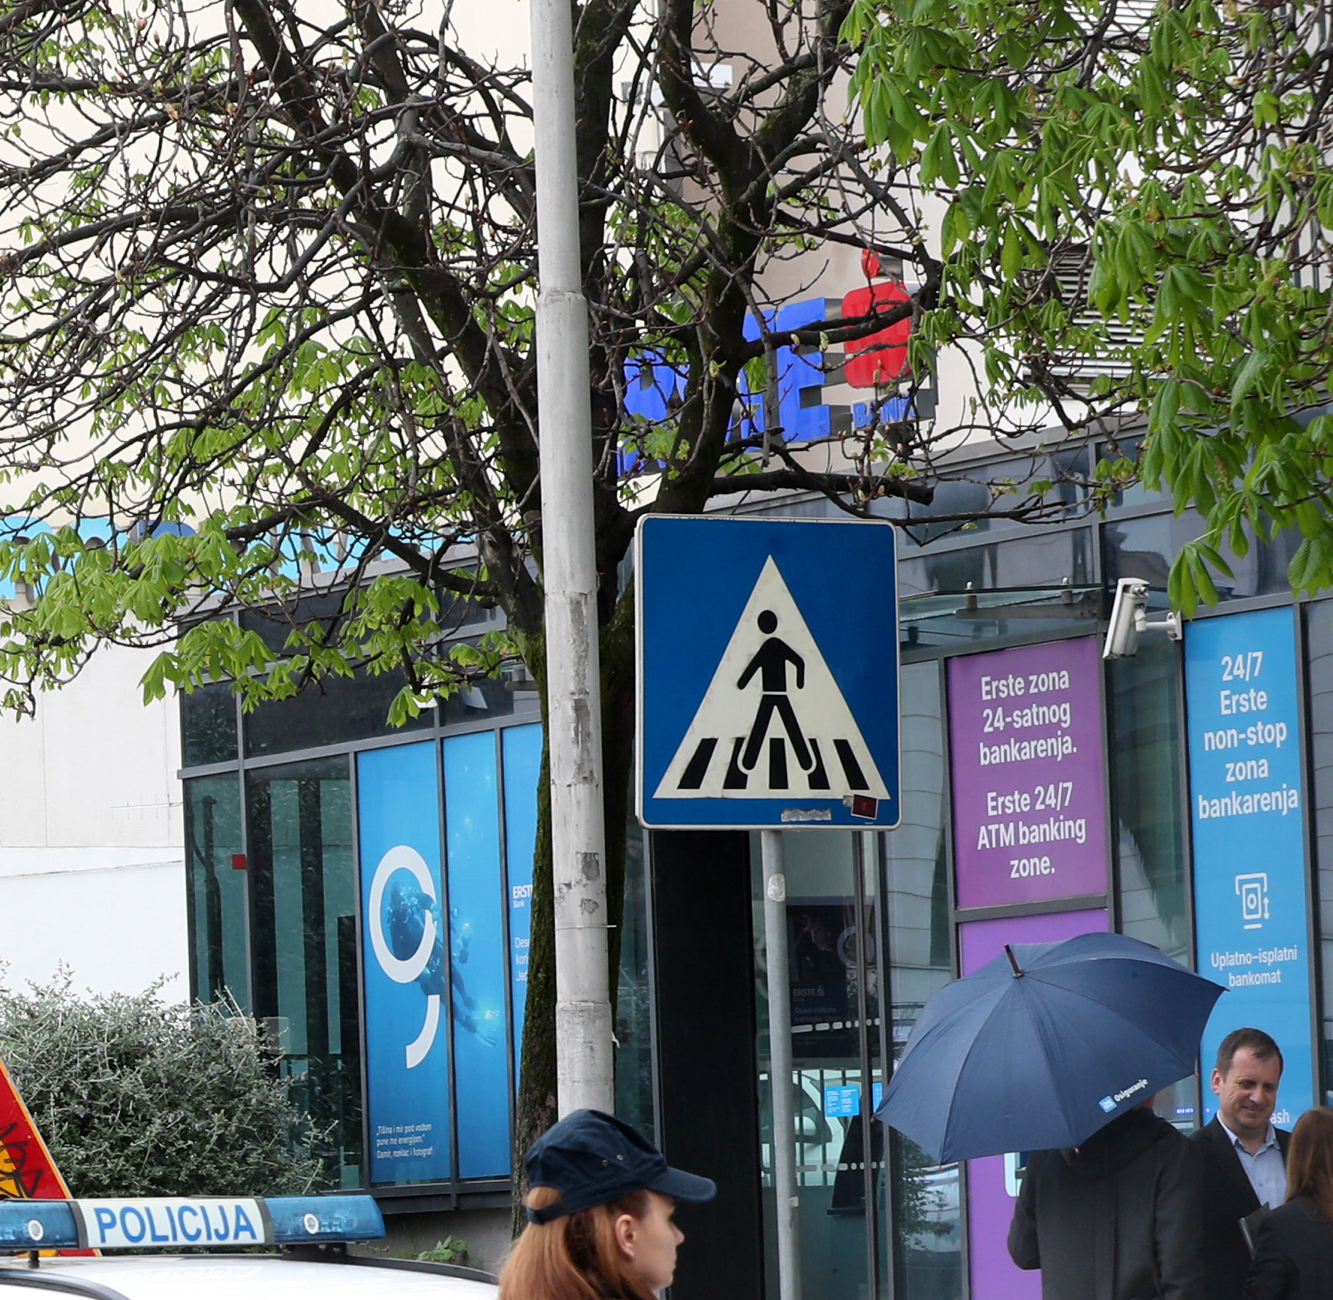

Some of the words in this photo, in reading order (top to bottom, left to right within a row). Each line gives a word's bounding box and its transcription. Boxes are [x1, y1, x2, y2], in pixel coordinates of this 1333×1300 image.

[1221, 651, 1263, 681] 24/7
[981, 674, 1025, 700] Erste
[1029, 669, 1070, 694] zona
[1220, 688, 1268, 715] Erste
[982, 702, 1071, 733] 24-satnog
[979, 730, 1078, 765] bankarenja.
[1204, 721, 1287, 751] non-stop
[1225, 758, 1269, 782] zona
[986, 790, 1031, 816] Erste
[1034, 781, 1073, 811] 24/7
[1198, 783, 1299, 819] bankarenja
[977, 822, 1015, 850] ATM
[1019, 815, 1086, 844] banking
[1009, 855, 1056, 878] zone.
[513, 885, 533, 899] ERST
[1229, 969, 1281, 987] bankomat
[1113, 1079, 1149, 1102] Osiguranje
[94, 1205, 258, 1244] POLICIJA
